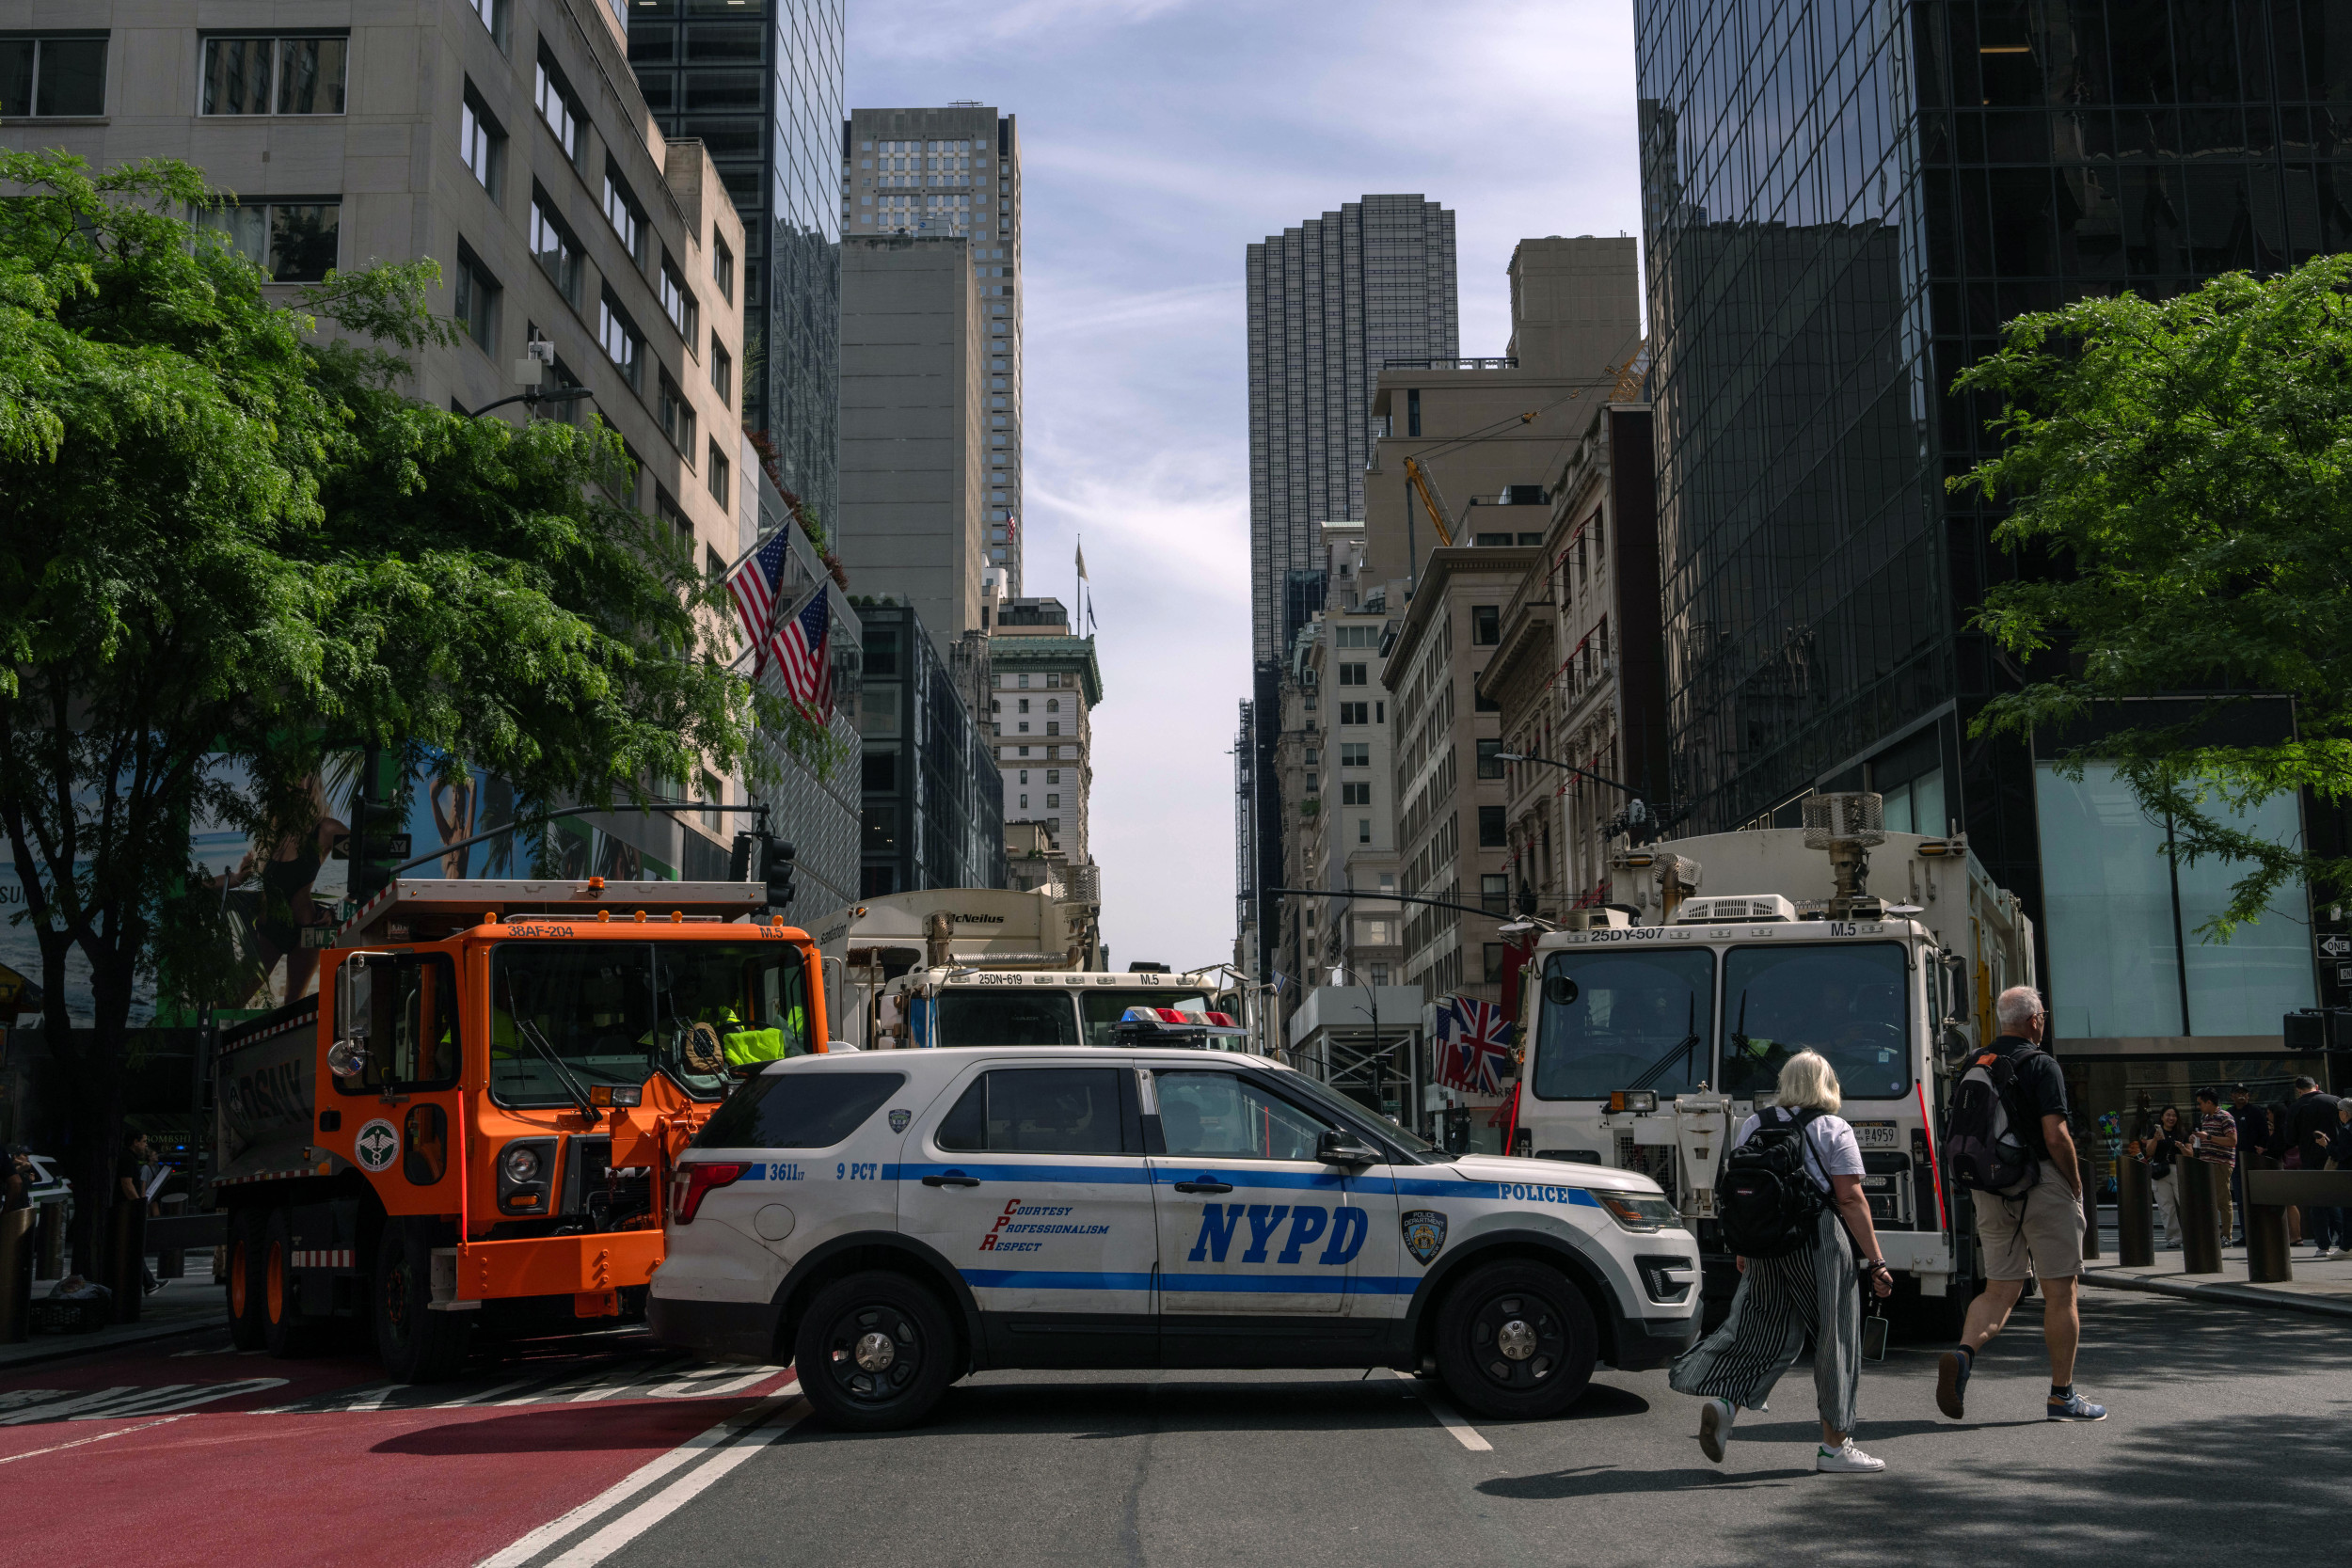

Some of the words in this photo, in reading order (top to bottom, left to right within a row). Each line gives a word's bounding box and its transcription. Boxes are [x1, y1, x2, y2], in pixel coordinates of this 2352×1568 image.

[951, 913, 1004, 924] cNeilus
[507, 925, 574, 938] 38AF-204
[759, 927, 784, 939] M.5
[1591, 927, 1664, 942] 25DY-507
[1831, 923, 1856, 937] M.5
[2328, 942, 2347, 951] ONE
[978, 974, 1023, 985] 25DN-619
[1140, 974, 1159, 985] M.5
[770, 1163, 798, 1180] 3611
[836, 1163, 845, 1180] 9
[850, 1163, 877, 1180] PCT
[1500, 1183, 1568, 1204] POLICE
[1404, 1217, 1444, 1227] DEPARTMENT
[1187, 1203, 1369, 1265] NYPD
[1430, 1244, 1440, 1258] NEW
[1437, 1230, 1445, 1244] YORK
